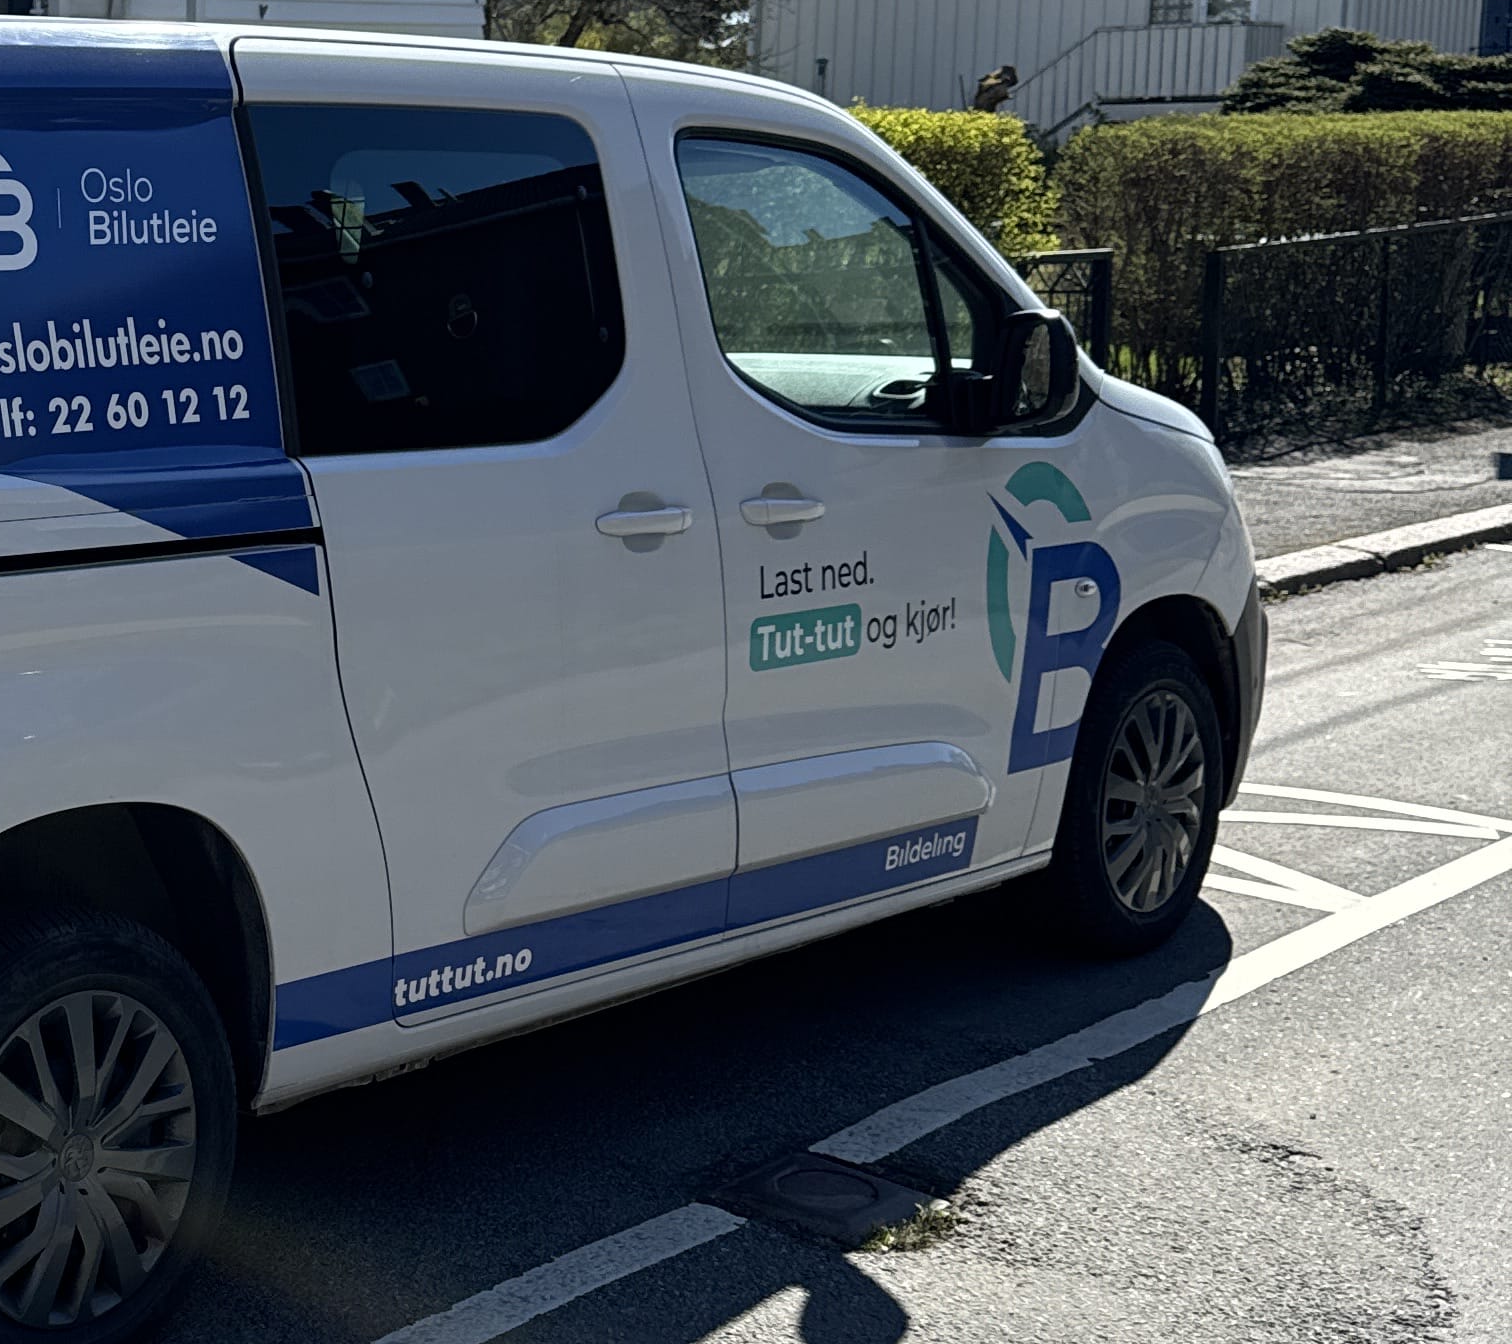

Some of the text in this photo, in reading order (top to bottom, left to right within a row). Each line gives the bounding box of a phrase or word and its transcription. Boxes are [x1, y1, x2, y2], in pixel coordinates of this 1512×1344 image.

[80, 167, 154, 203] Oslo
[88, 209, 218, 246] Bilutleie
[47, 395, 94, 434] 22
[106, 391, 150, 430] 60
[160, 387, 201, 425] 12
[212, 384, 251, 421] 12
[759, 550, 875, 600] Last ned.
[756, 596, 957, 661] Tut-tut og kjør!
[884, 831, 967, 872] Bildeling
[394, 948, 533, 1007] tuttut.no
